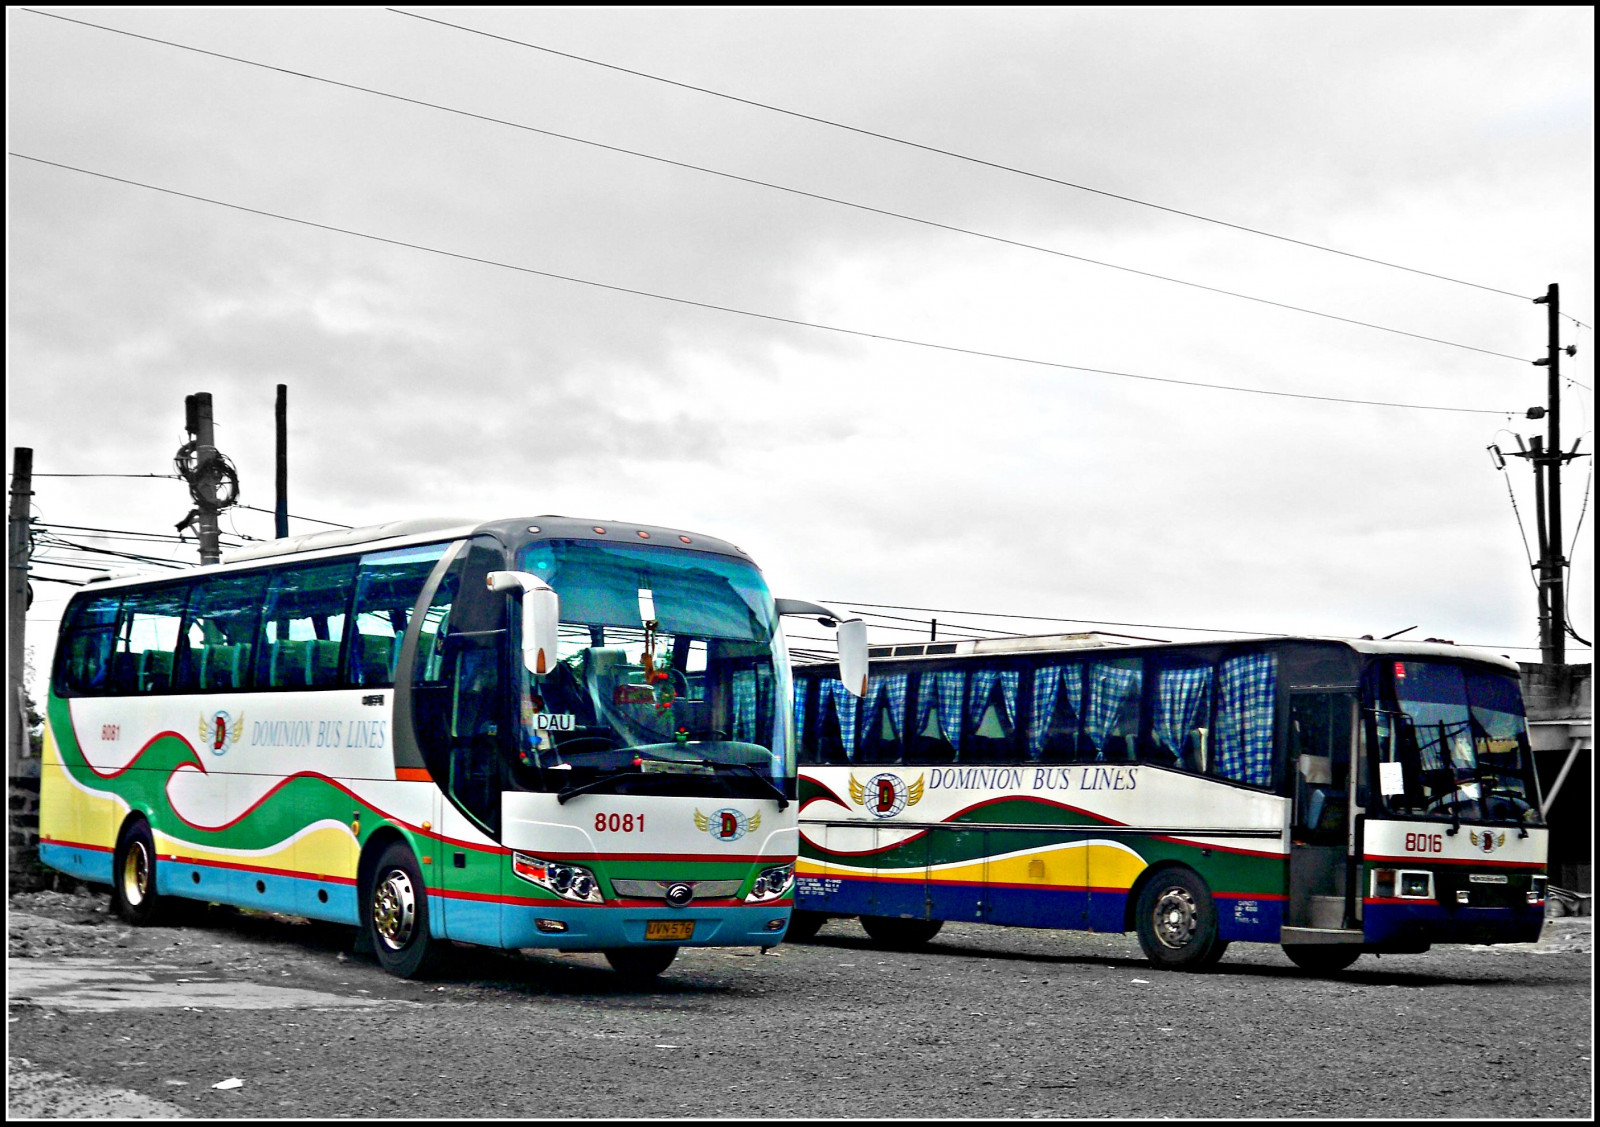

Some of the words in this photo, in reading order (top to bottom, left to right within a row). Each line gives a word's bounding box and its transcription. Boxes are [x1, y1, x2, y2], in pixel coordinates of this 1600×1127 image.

[537, 714, 571, 730] DAU
[102, 724, 120, 741] 8081
[252, 721, 313, 747] DOMINION
[317, 721, 342, 748] BUS
[346, 721, 386, 748] LINES
[929, 768, 1022, 790] DOMINION
[1033, 769, 1070, 790] BUS
[1080, 769, 1138, 790] LINES
[595, 812, 645, 833] 8081
[1405, 833, 1442, 853] 8016
